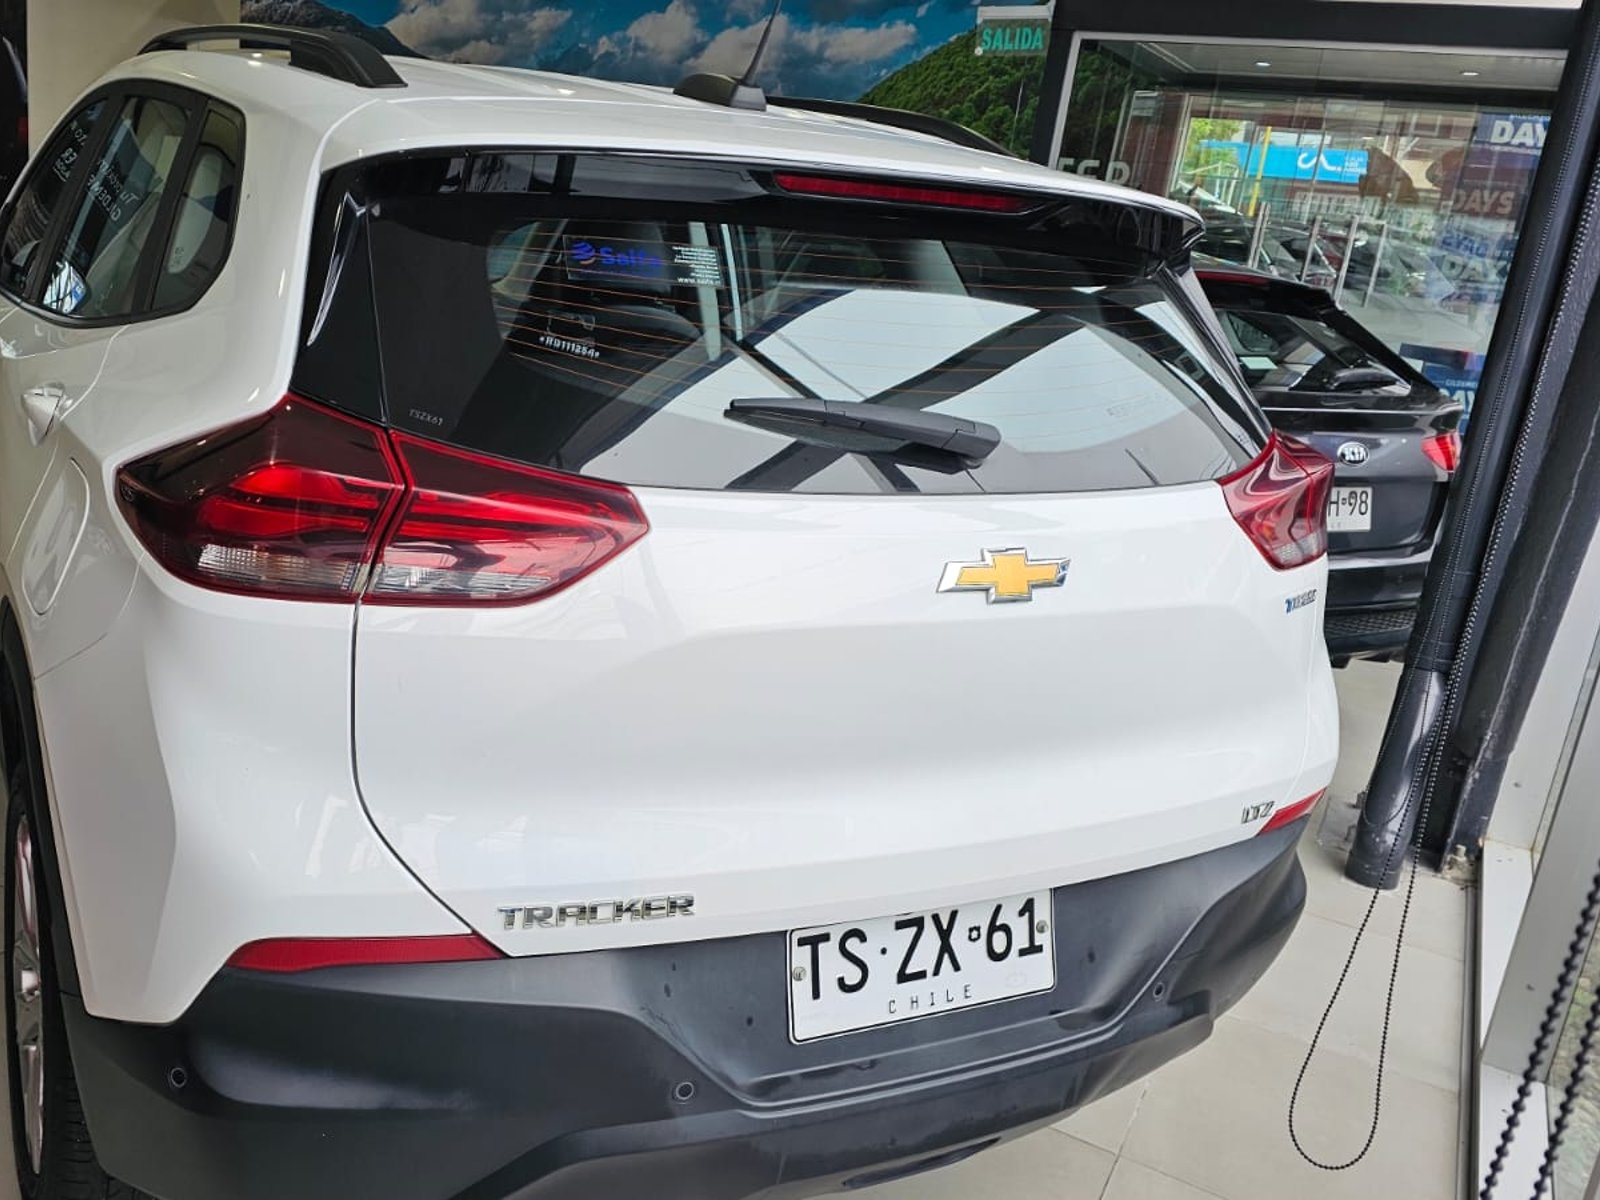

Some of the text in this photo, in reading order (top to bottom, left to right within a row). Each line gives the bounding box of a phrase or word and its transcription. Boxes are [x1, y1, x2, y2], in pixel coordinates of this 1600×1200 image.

[982, 27, 1043, 49] SALIDA
[1241, 801, 1274, 824] LTZ
[497, 895, 695, 930] TRACKER
[888, 984, 972, 1014] CHILE
